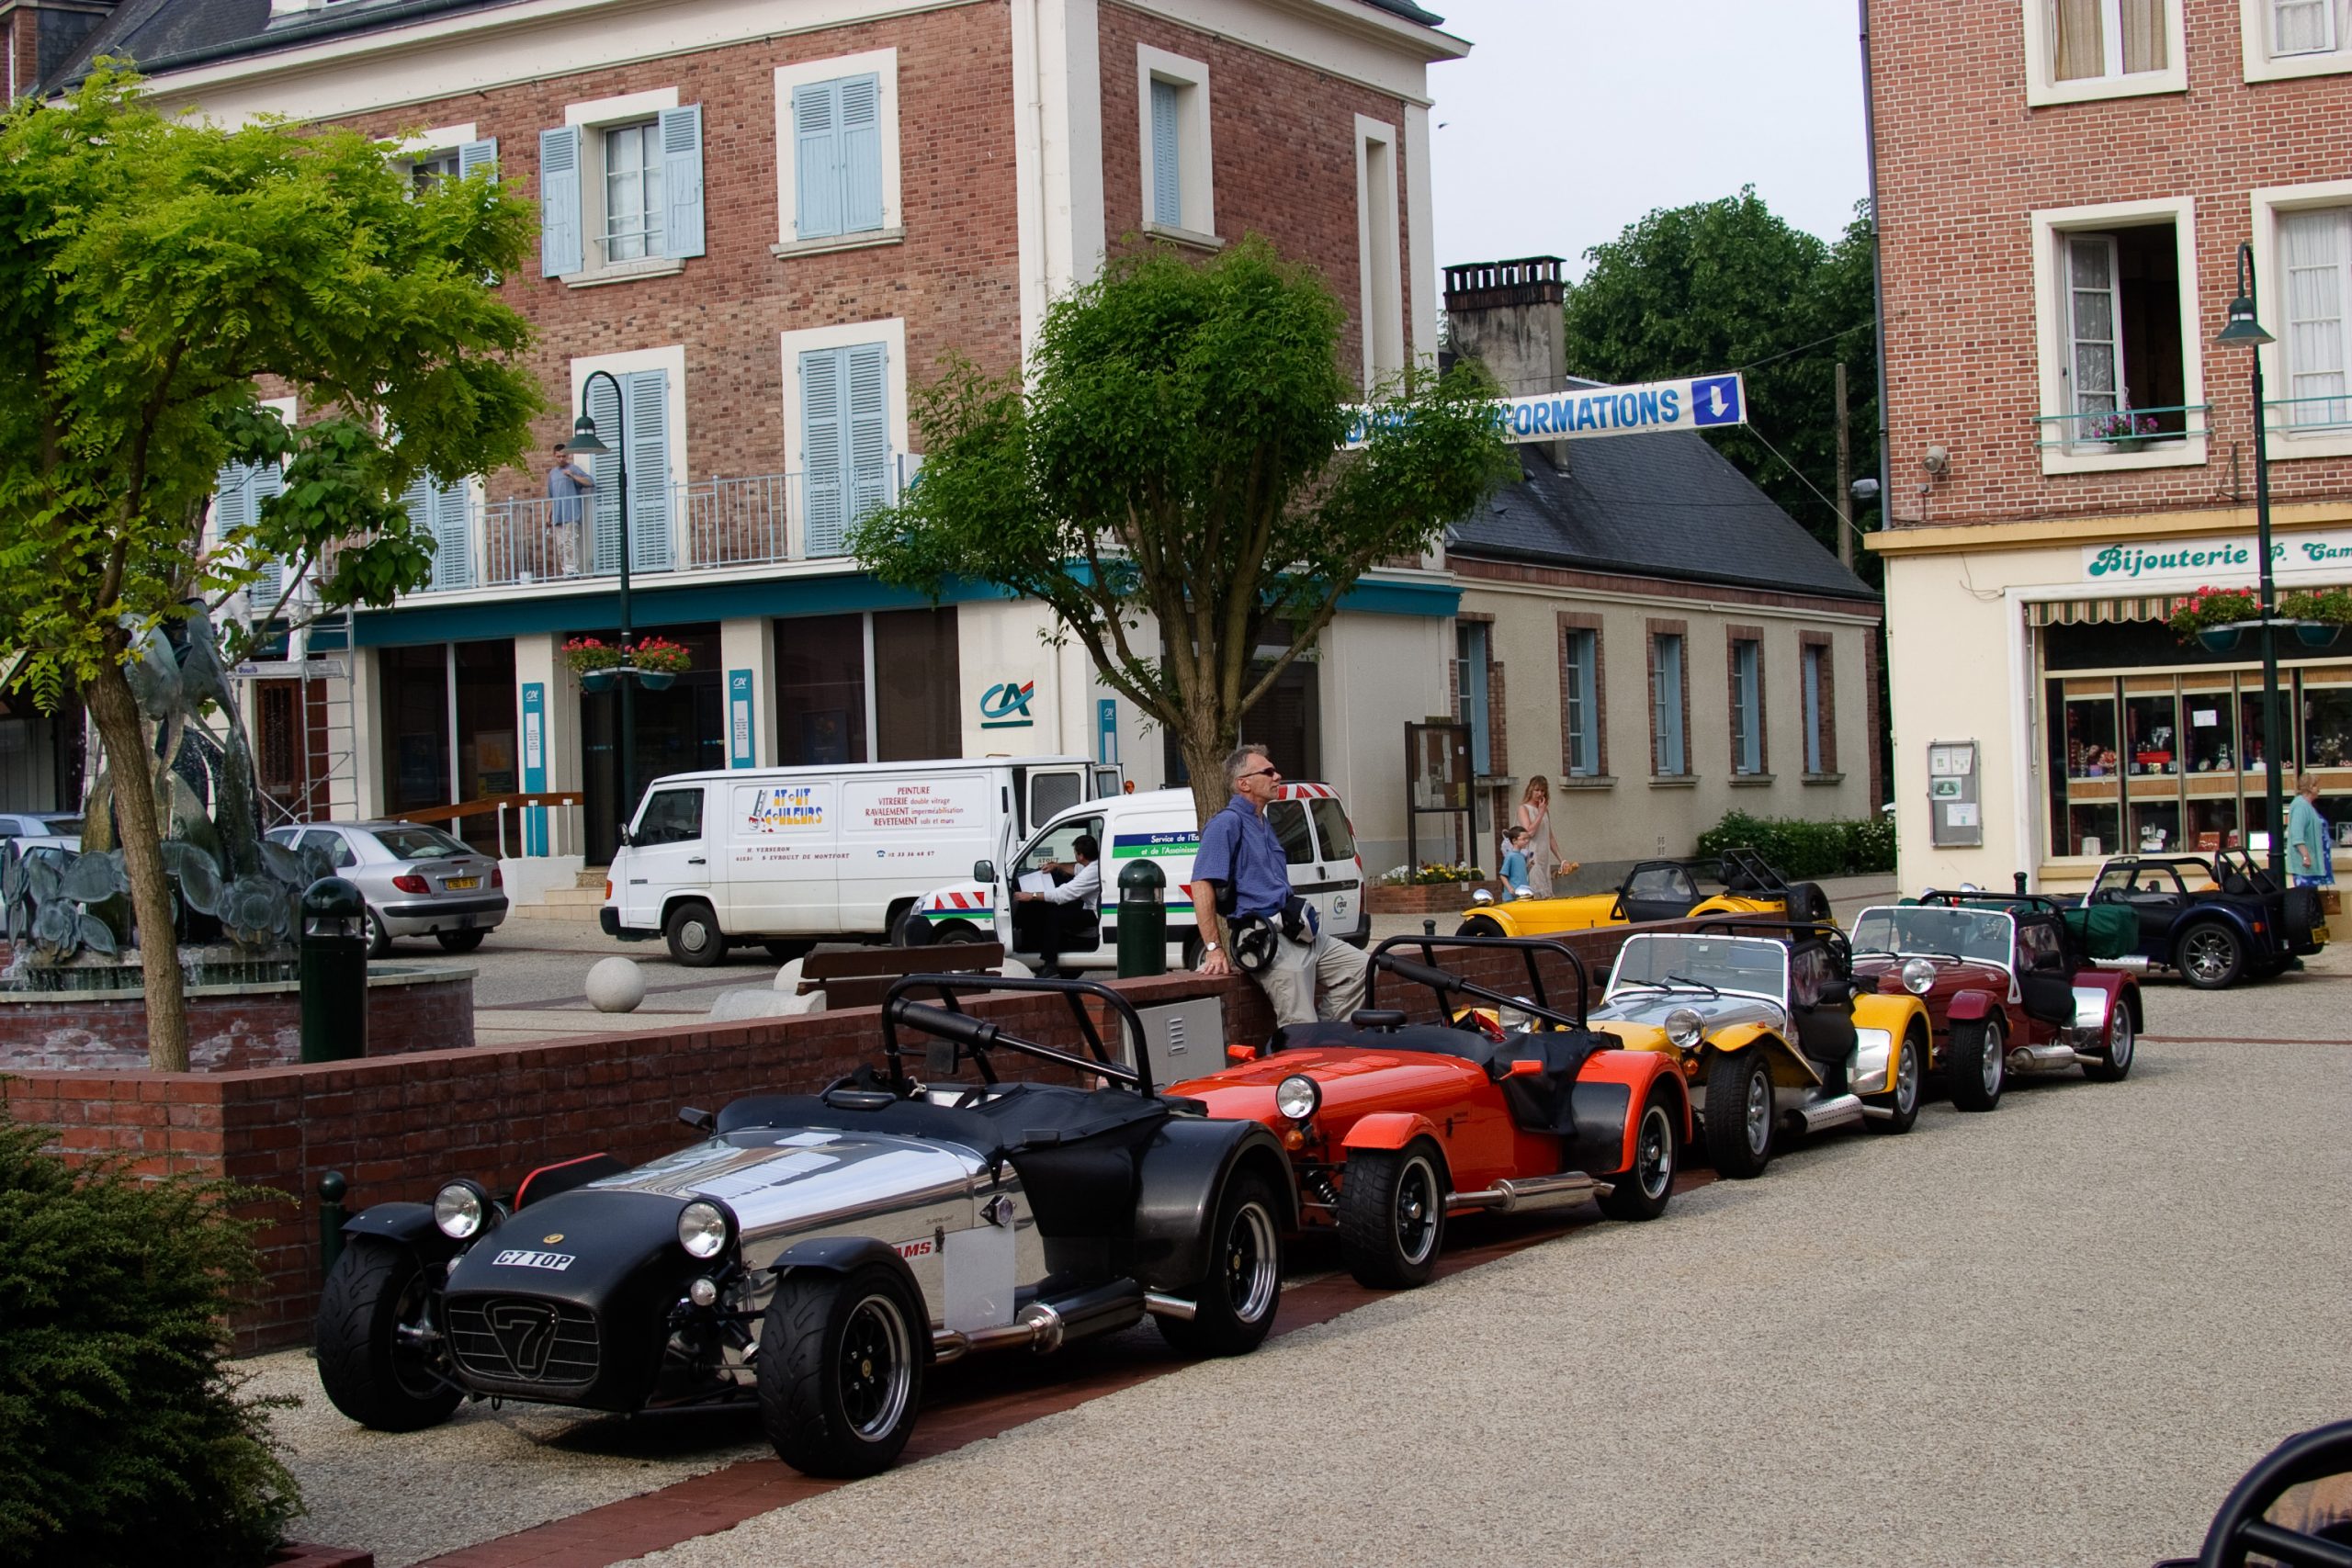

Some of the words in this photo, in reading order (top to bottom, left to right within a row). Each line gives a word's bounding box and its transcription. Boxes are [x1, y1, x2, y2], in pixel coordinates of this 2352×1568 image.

[1477, 389, 1679, 436] FORMATIONS
[2088, 543, 2249, 577] Bijouterie
[980, 680, 1034, 718] CA
[774, 788, 810, 807] ATOUT
[898, 786, 931, 795] PEINTURE
[878, 797, 908, 806] VITRERIE
[931, 797, 950, 806] vitrage
[765, 807, 822, 825] COULEURS
[865, 807, 909, 817] RAVALEMENT
[874, 818, 917, 826] REVETEMENT
[1151, 835, 1174, 843] Service
[1177, 834, 1185, 842] de
[497, 1251, 526, 1264] C7
[528, 1252, 571, 1268] TOP
